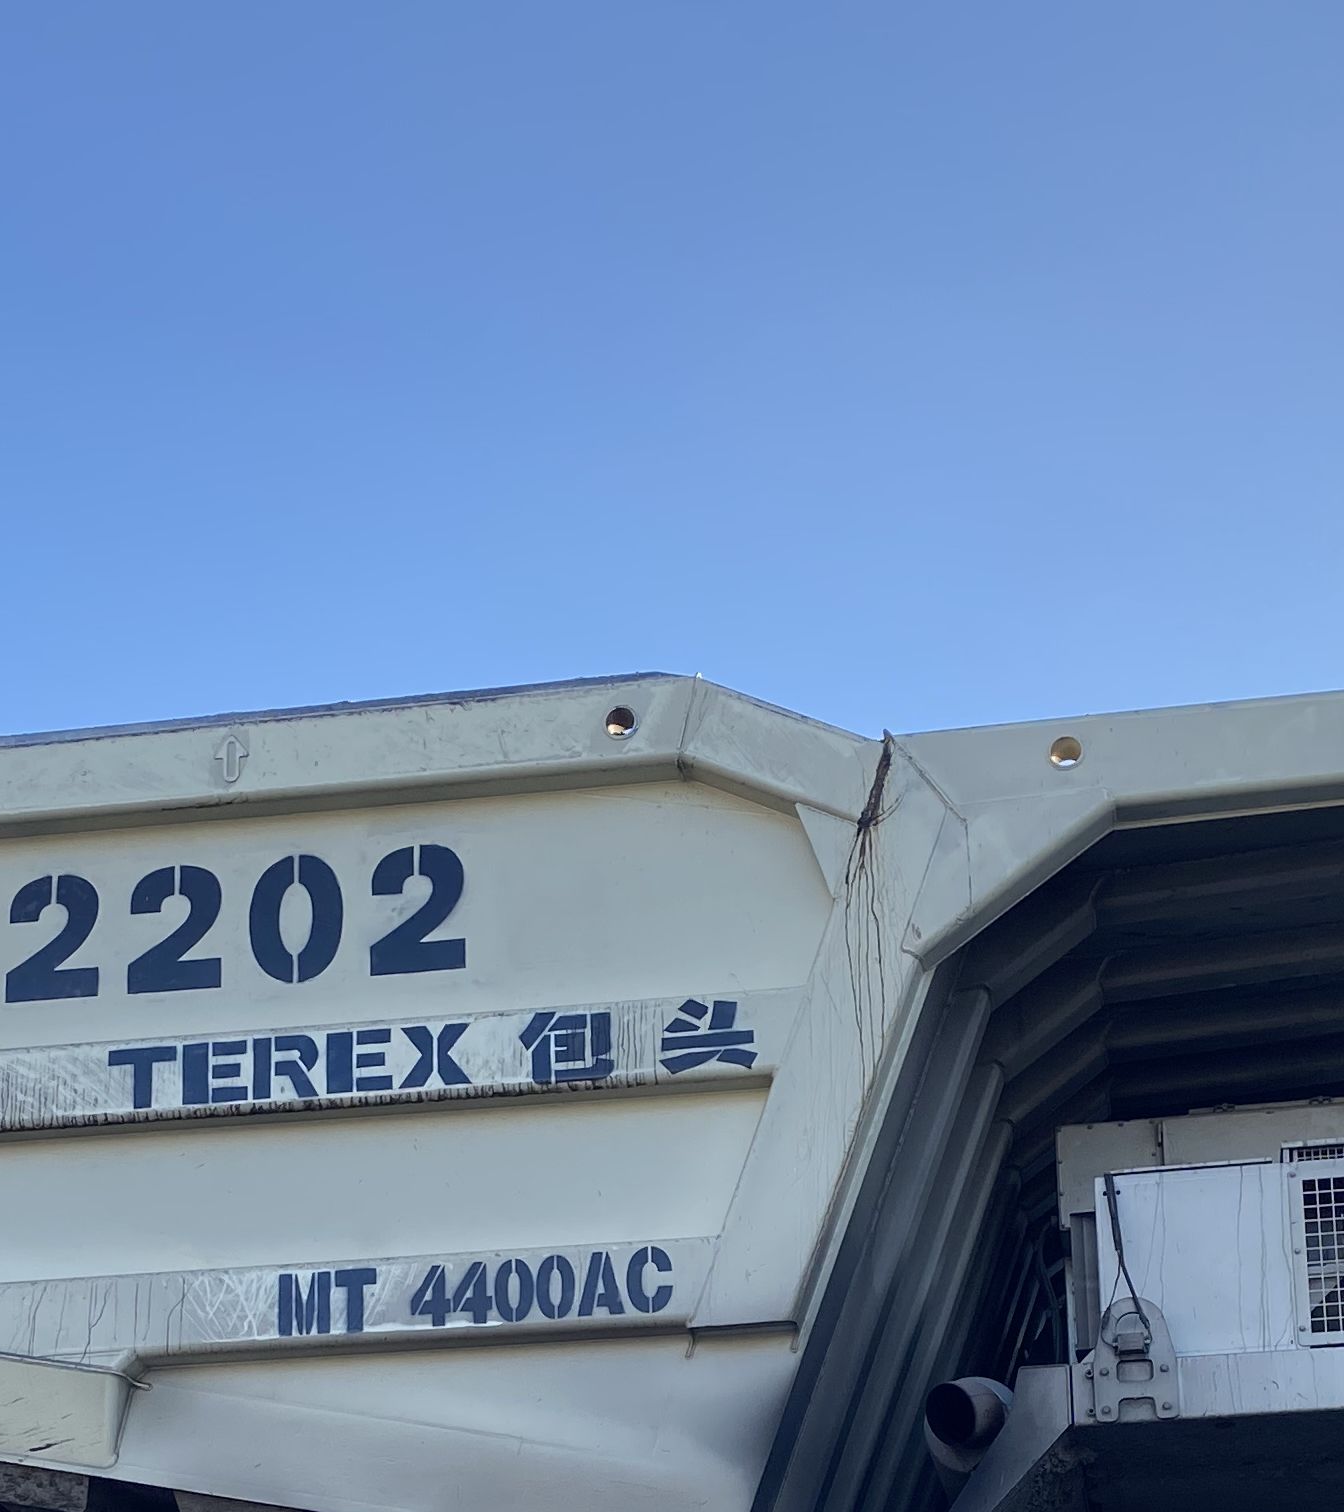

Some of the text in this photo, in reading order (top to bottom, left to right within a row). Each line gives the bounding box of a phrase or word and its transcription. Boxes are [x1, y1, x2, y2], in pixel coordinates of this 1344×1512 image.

[5, 844, 466, 1003] 2202
[108, 999, 758, 1109] TEREX 包头
[278, 1245, 674, 1337] MT 4400AC
